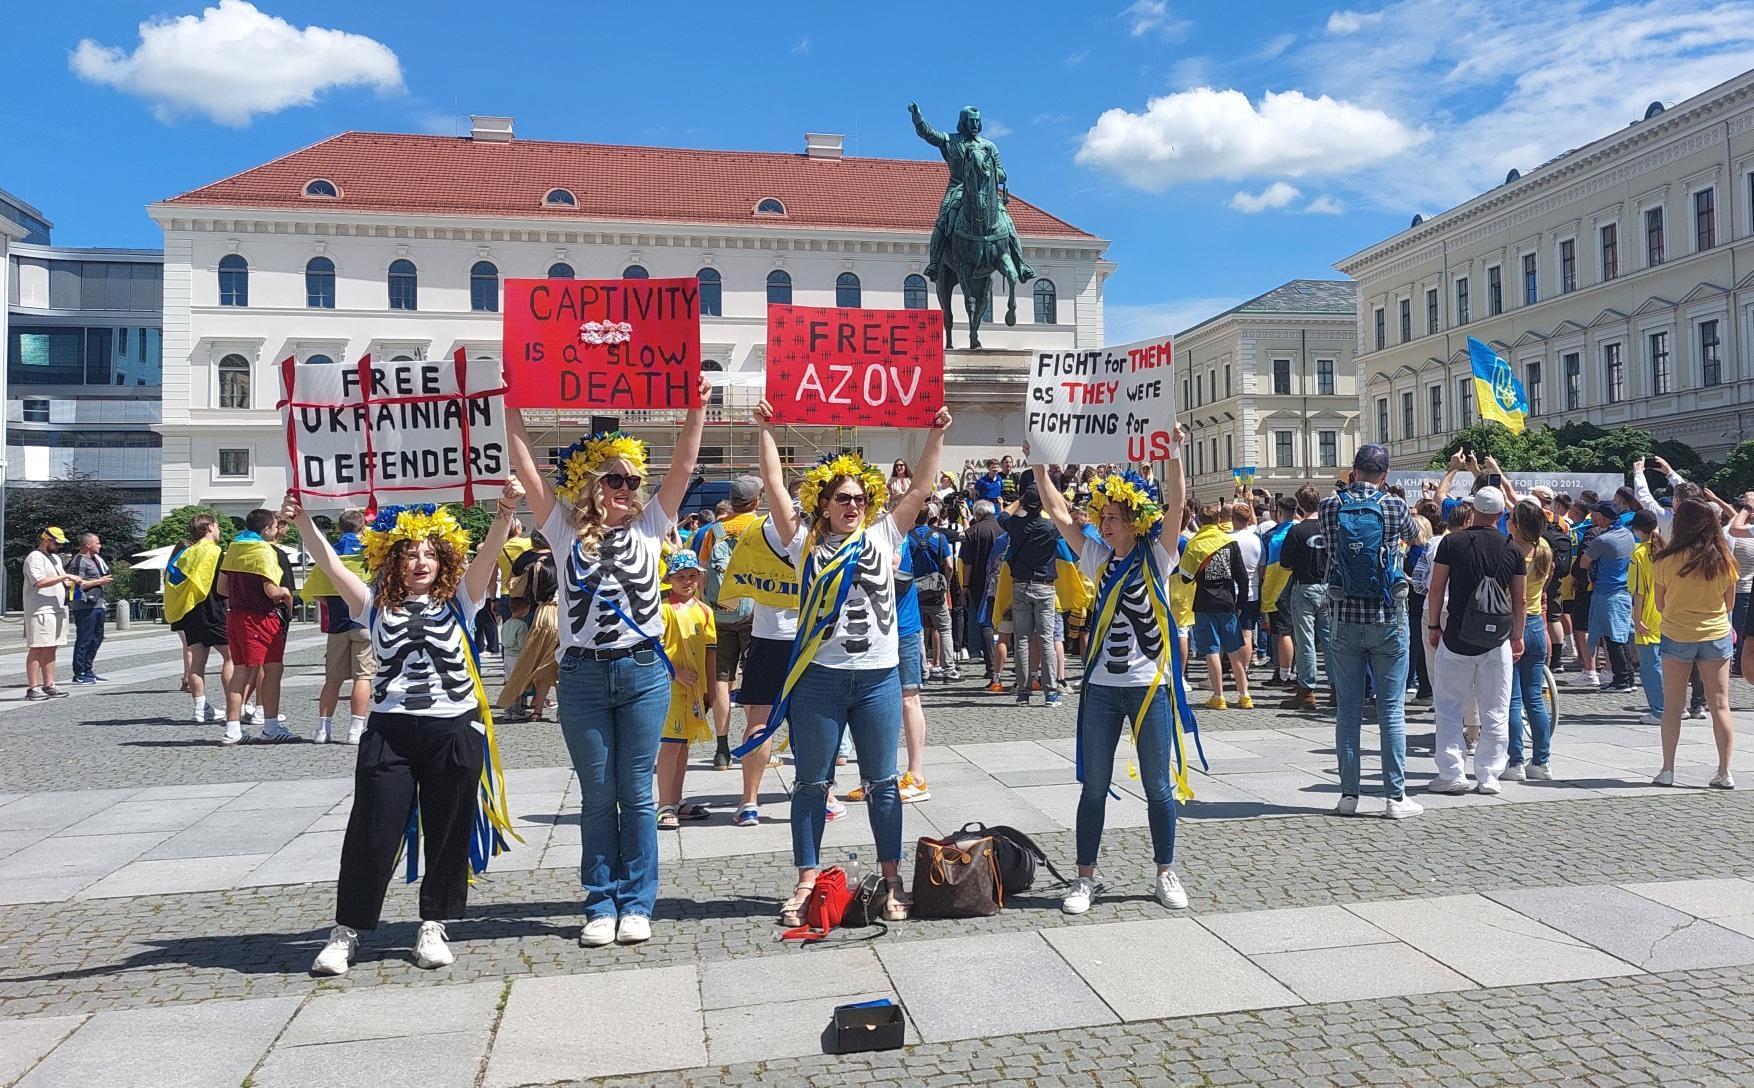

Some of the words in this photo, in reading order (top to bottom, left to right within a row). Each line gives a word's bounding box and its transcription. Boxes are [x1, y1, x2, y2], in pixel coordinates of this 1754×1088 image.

[530, 285, 697, 321] CAPTIVITY
[563, 344, 582, 364] a
[606, 342, 686, 368] SLOW
[809, 321, 910, 356] FREE
[1037, 352, 1102, 377] FIGHT
[1105, 353, 1127, 374] for
[1128, 341, 1171, 373] THEM
[342, 366, 440, 397] FREE
[560, 370, 690, 407] DEATH
[795, 363, 922, 407] AZOV
[1061, 380, 1119, 404] THEY
[301, 396, 492, 433] UKRAINIAN
[1028, 412, 1119, 435] FIGHTING
[1126, 412, 1149, 435] for
[1128, 430, 1171, 463] US
[304, 443, 503, 487] DEFENDERS
[1514, 480, 1533, 488] FOR
[1560, 480, 1584, 489] 2012,
